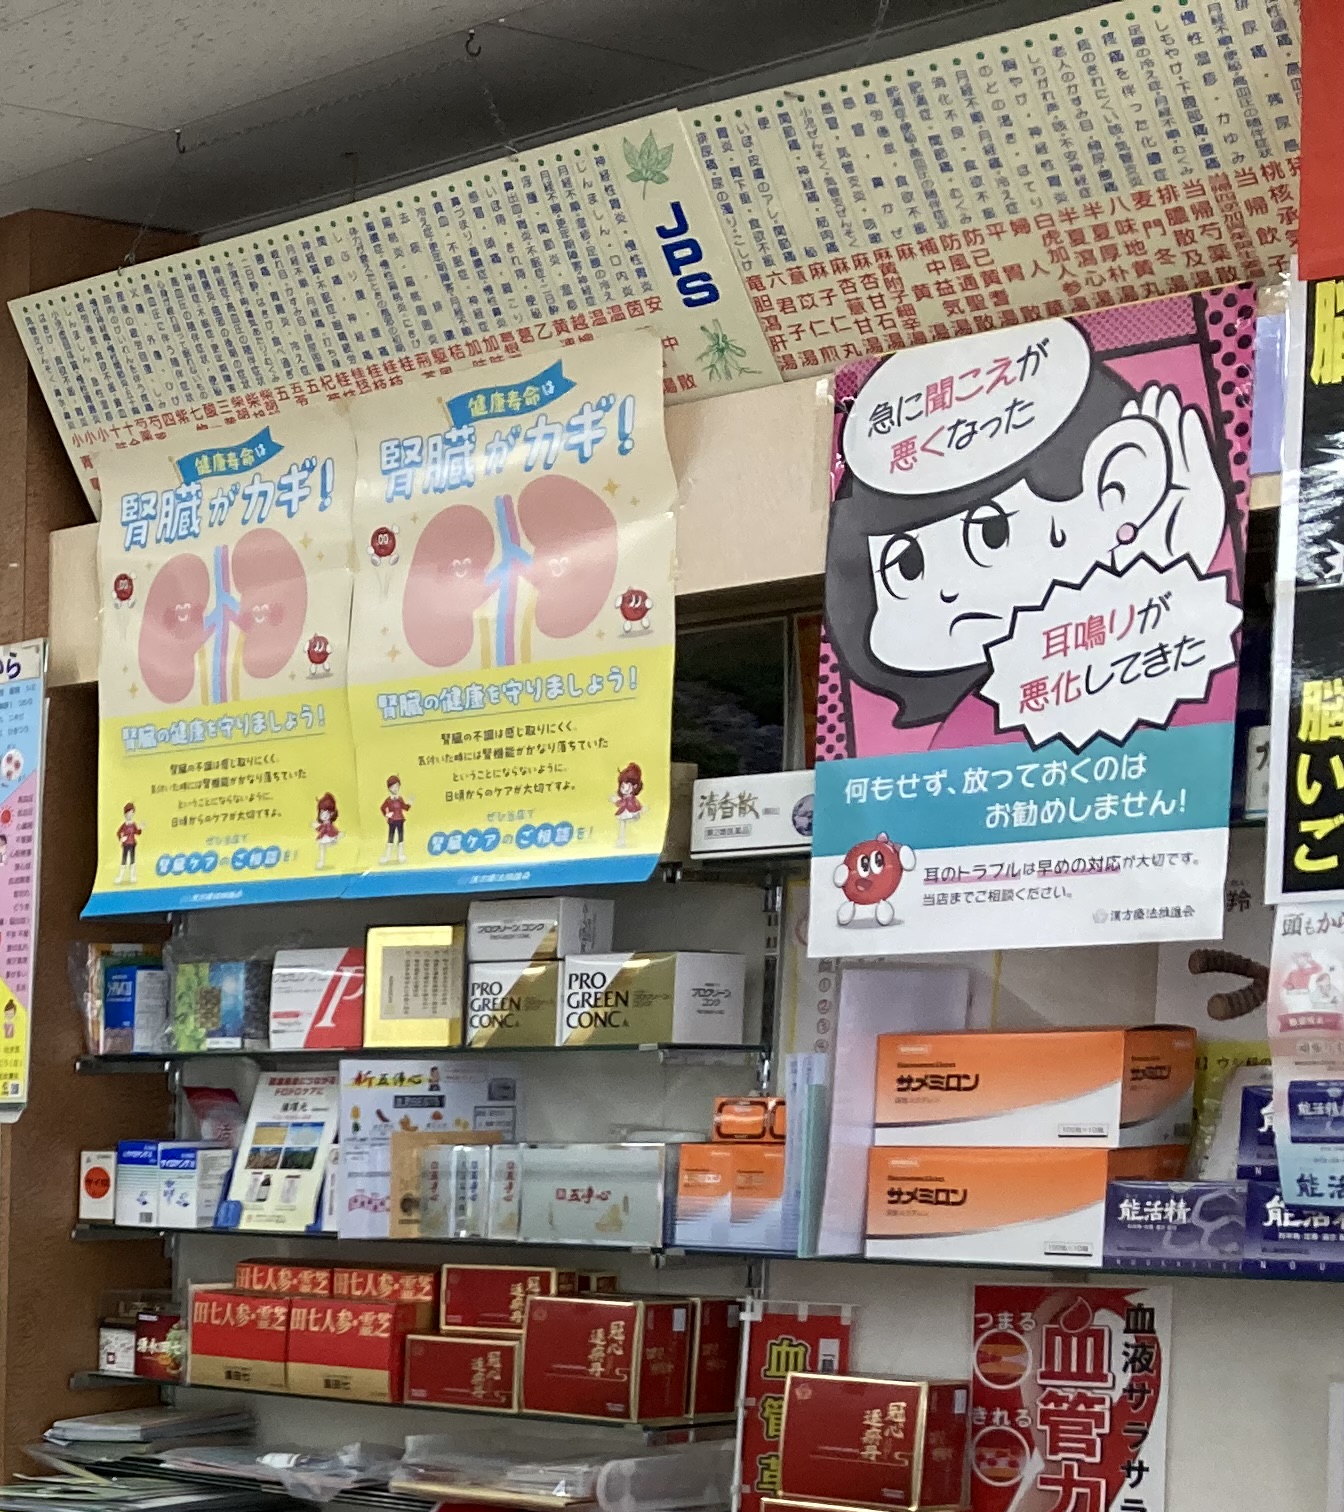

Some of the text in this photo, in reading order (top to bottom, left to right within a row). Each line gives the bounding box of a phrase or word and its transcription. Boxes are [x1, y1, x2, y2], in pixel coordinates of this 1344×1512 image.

[655, 201, 720, 308] JPS
[467, 380, 555, 417] 健康寿命は
[867, 338, 1051, 436] 急に聞こえが
[889, 398, 1036, 473] 悪くなった
[1041, 592, 1172, 660] 耳鳴りが
[1018, 635, 1205, 712] 悪化してきた
[844, 753, 1147, 805] 何もせず、放っておくのは
[923, 853, 1200, 884] 耳のトラブルは早めの対応が大切です。
[921, 884, 1074, 907] 当店までご相談ください。
[470, 981, 503, 997] PRO
[568, 973, 607, 990] PRO
[470, 996, 521, 1012] GREEN
[567, 990, 629, 1009] GREEN
[895, 1073, 979, 1092] サメミロン
[887, 1187, 967, 1206] サメミロン
